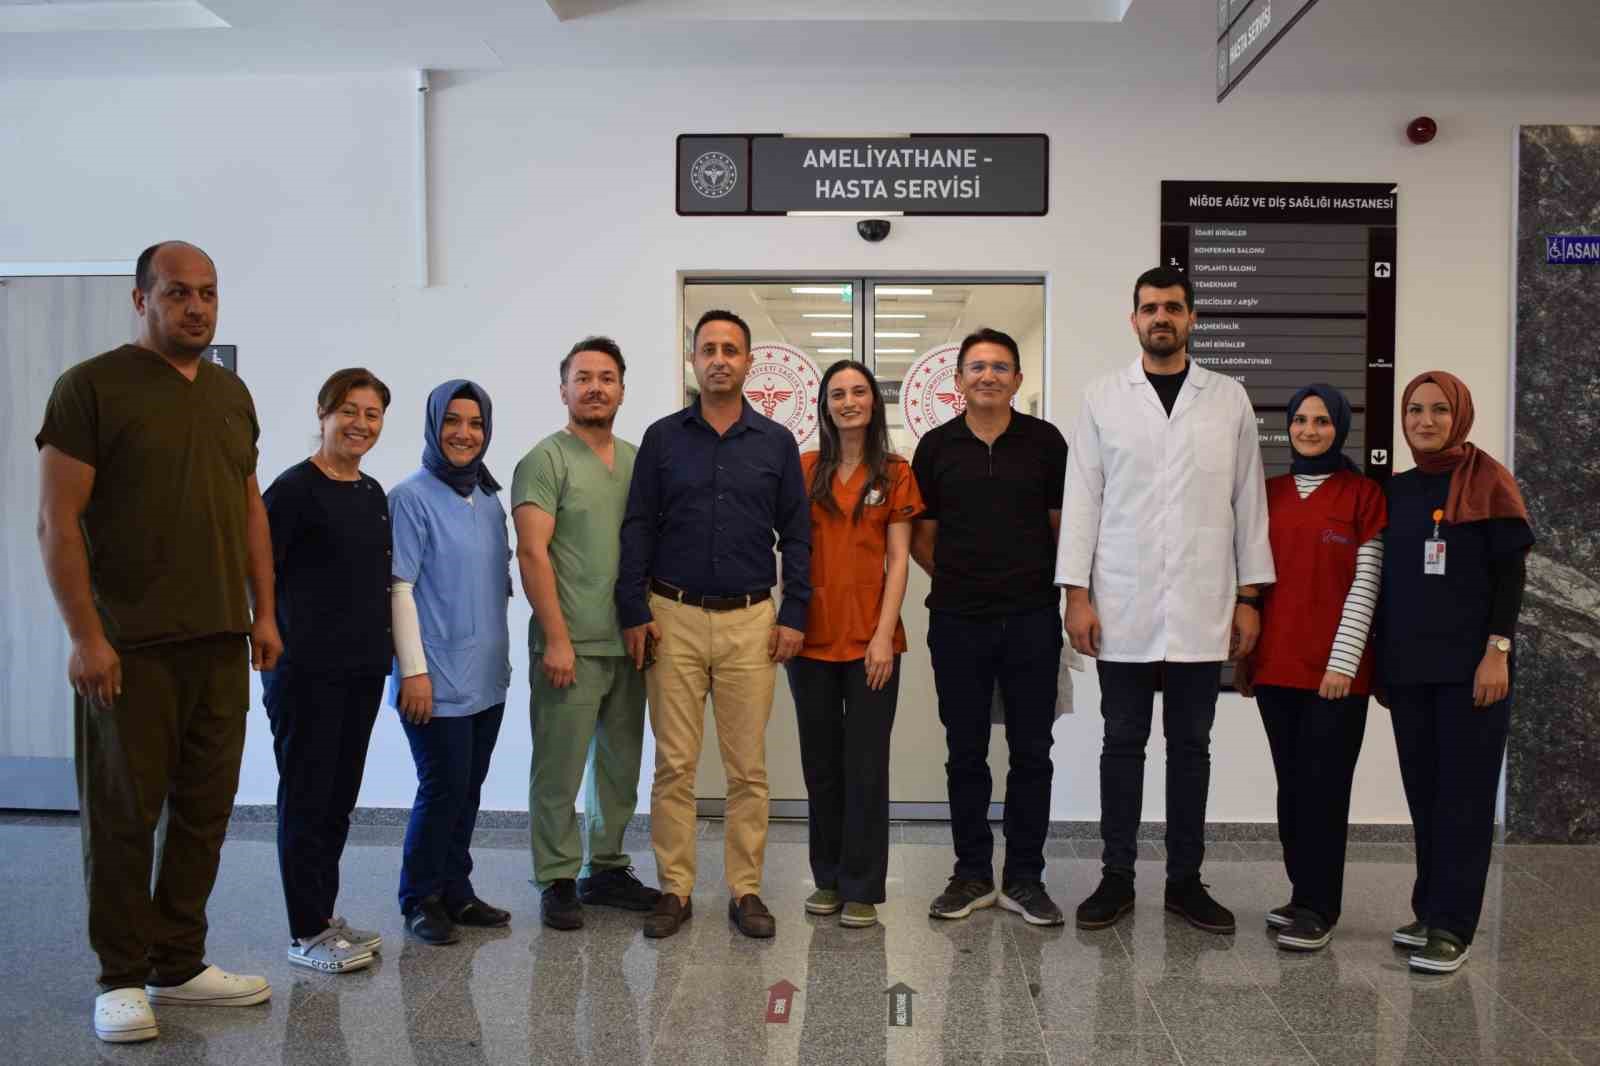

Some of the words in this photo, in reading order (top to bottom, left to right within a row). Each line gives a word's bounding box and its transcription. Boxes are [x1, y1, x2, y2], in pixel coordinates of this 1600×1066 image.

[802, 145, 977, 168] AMELİYATHANE
[815, 179, 888, 198] HASTA
[894, 175, 980, 198] SERVİSİ
[1189, 194, 1223, 207] NİĞDE
[1225, 194, 1250, 207] AĞIZ
[1252, 197, 1266, 207] VE
[1268, 195, 1286, 210] DİŞ
[1288, 195, 1331, 208] SAĞLIĞI
[1333, 196, 1393, 209] HASTANESİ
[311, 960, 345, 970] crocs
